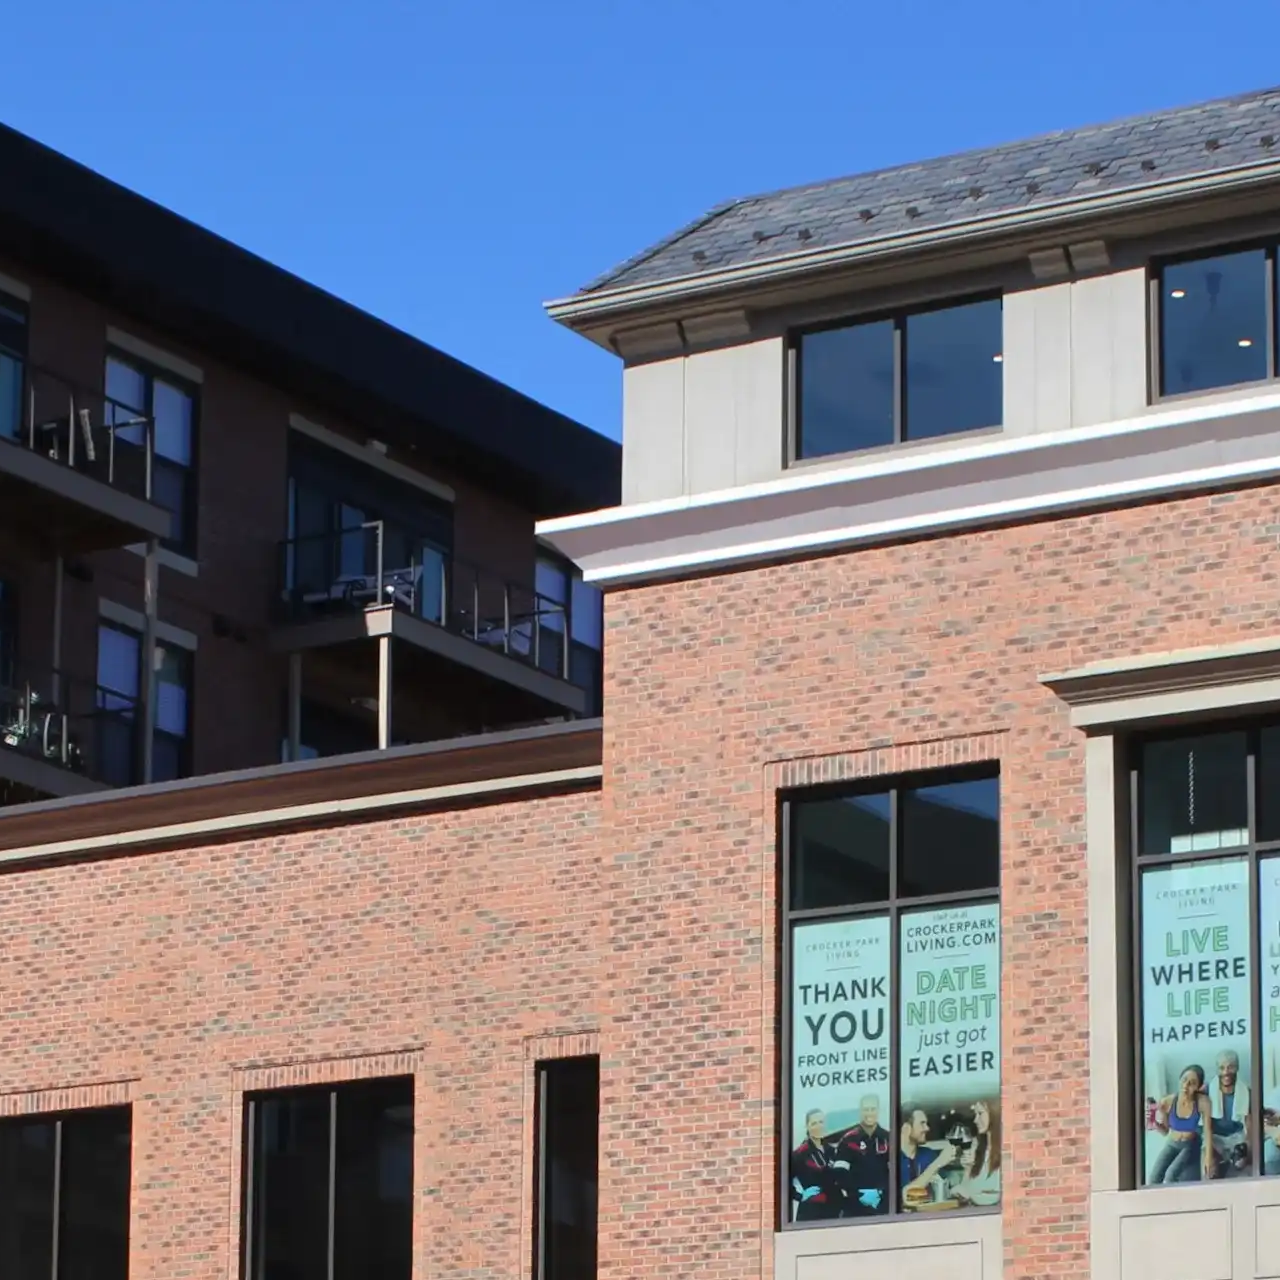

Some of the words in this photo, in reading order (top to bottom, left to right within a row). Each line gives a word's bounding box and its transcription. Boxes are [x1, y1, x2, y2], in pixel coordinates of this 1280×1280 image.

[907, 918, 995, 937] CROCKERPARK
[1166, 926, 1229, 957] LIVE
[907, 932, 996, 953] LIVING.COM
[916, 964, 987, 994] DATE
[1151, 957, 1246, 986] WHERE
[799, 976, 887, 1005] THANK
[1166, 987, 1229, 1018] LIFE
[907, 994, 996, 1026] NIGHT
[804, 1008, 884, 1046] YOU
[917, 1028, 949, 1052] just
[956, 1025, 987, 1050] got
[1151, 1019, 1246, 1043] HAPPENS
[798, 1051, 847, 1068] FRONT
[854, 1047, 887, 1063] LINE
[908, 1051, 995, 1077] EASIER
[800, 1067, 888, 1089] WORKERS
